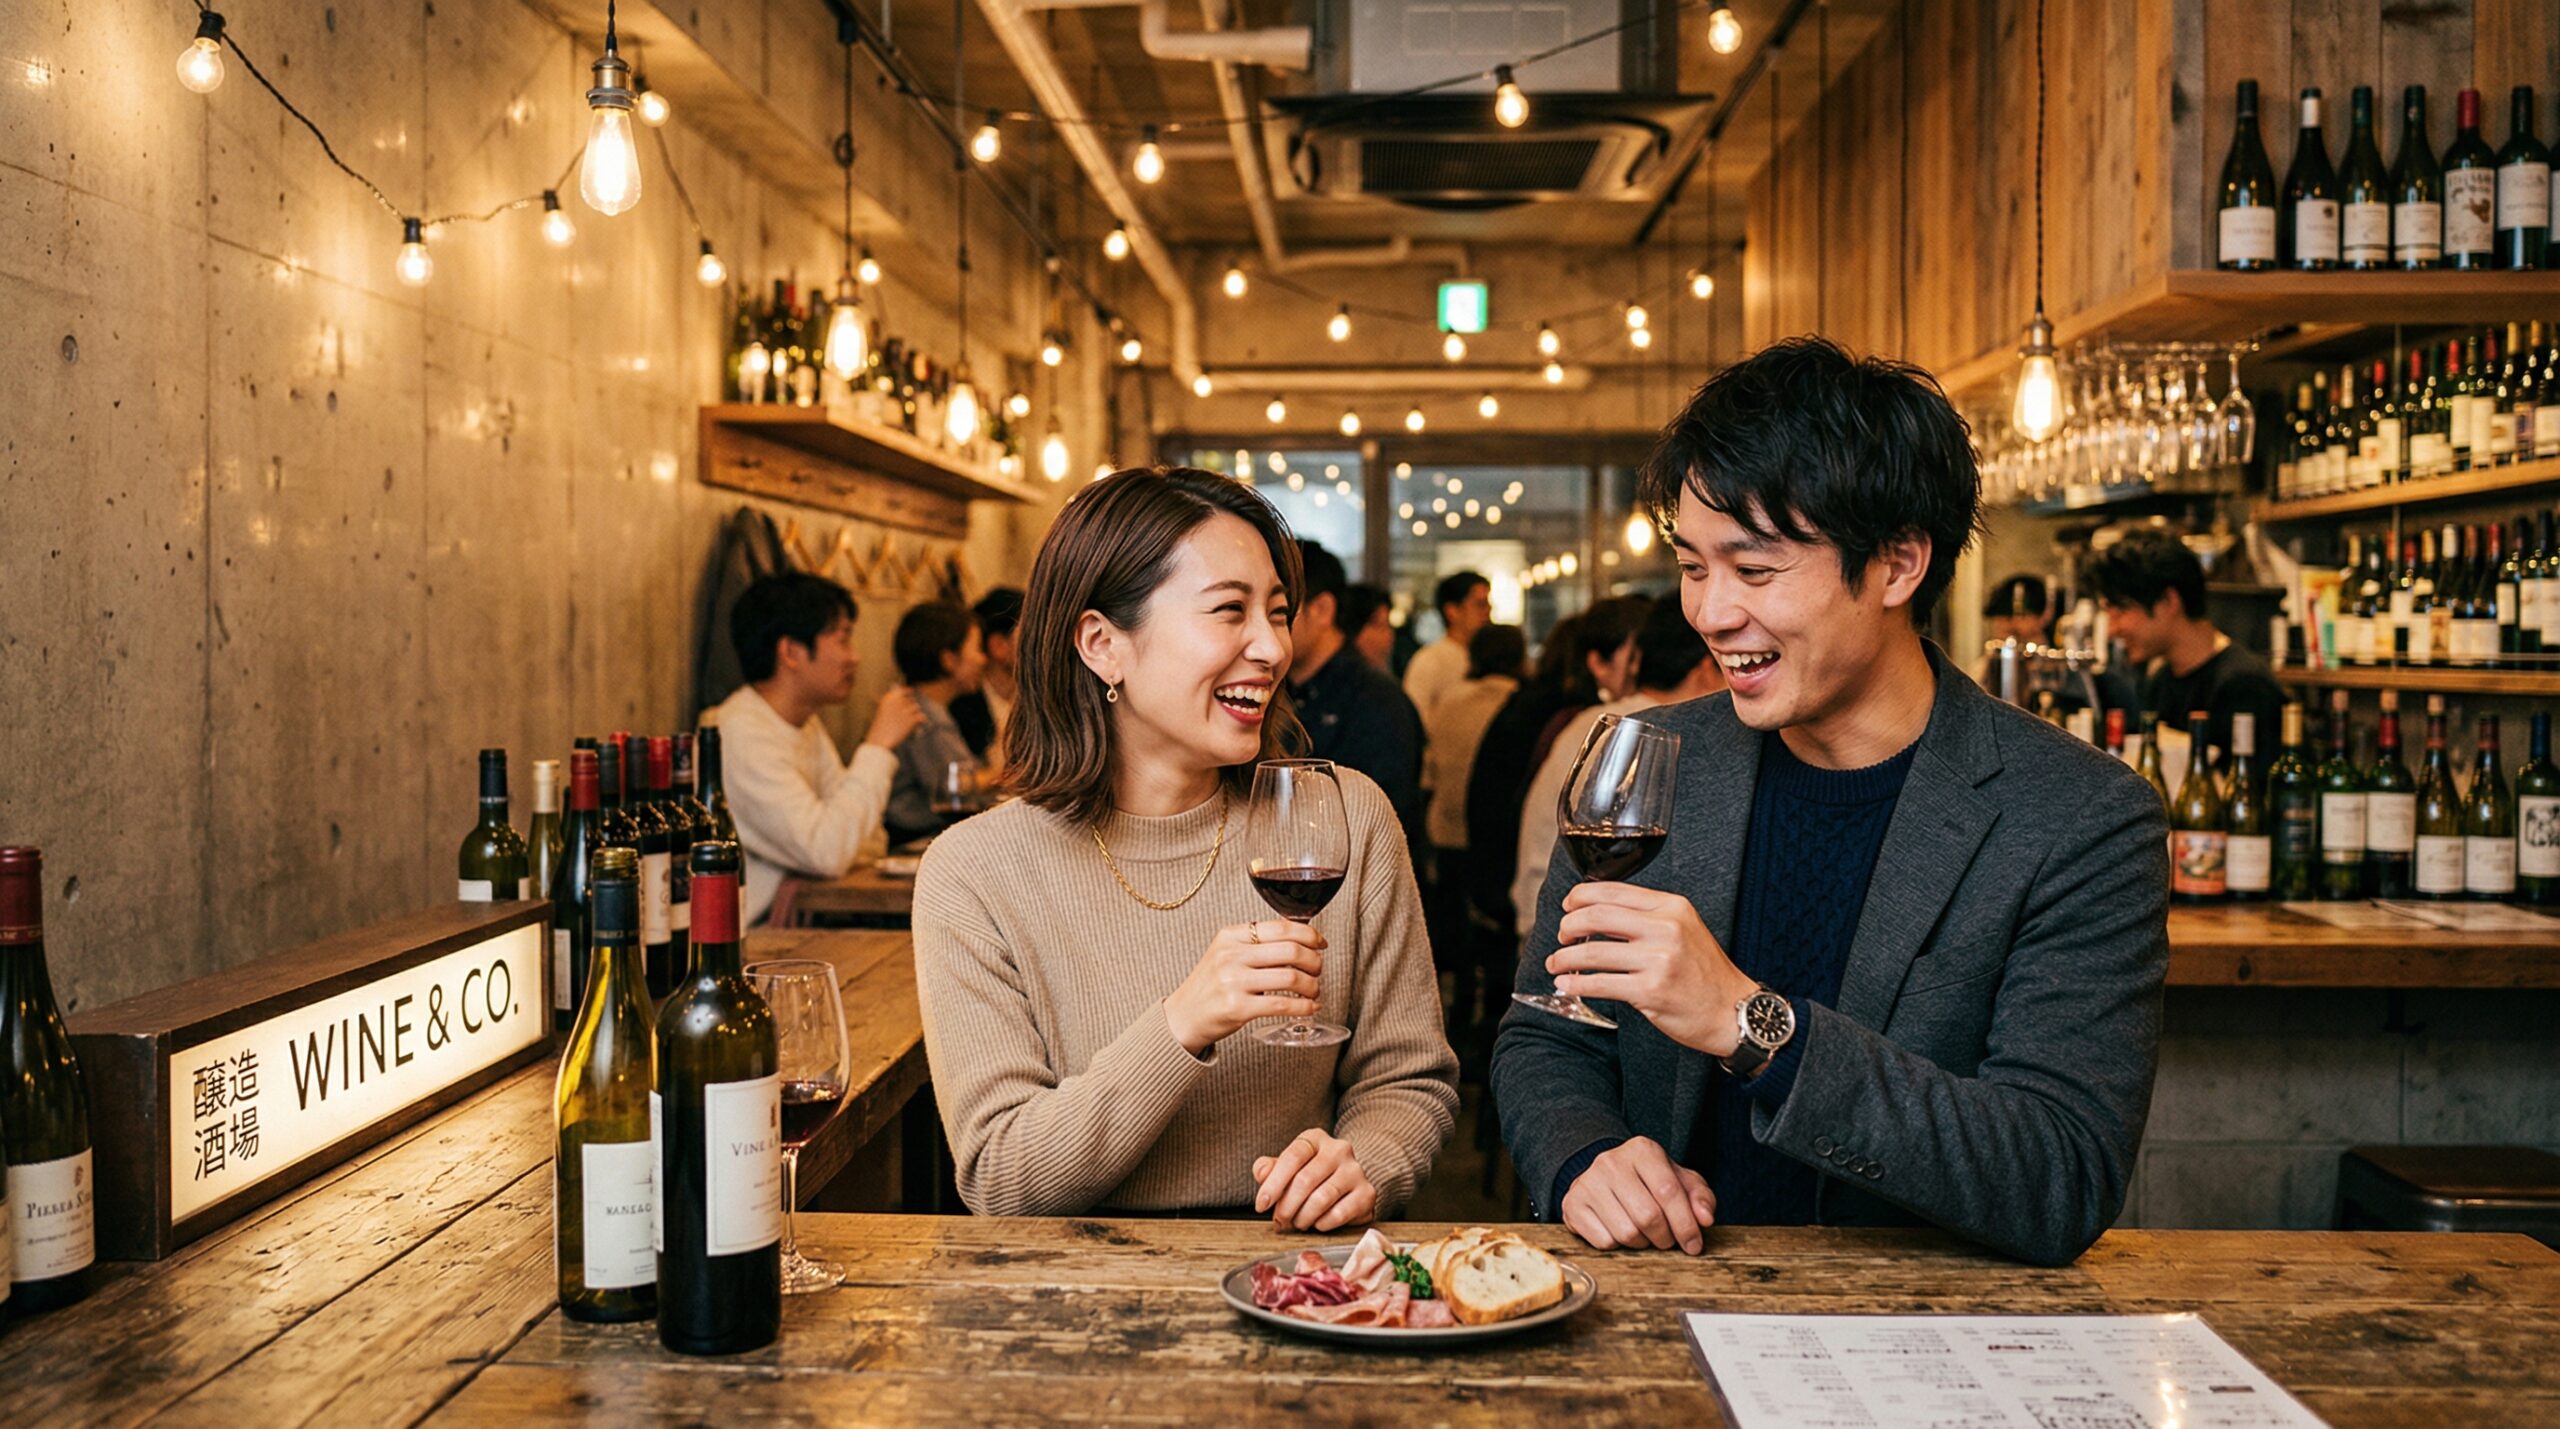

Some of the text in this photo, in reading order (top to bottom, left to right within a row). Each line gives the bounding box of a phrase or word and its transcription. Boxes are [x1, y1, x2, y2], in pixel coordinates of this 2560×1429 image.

[289, 958, 519, 1111] WINE & CO.
[193, 1048, 260, 1122] 醸造
[194, 1106, 260, 1181] 酒場
